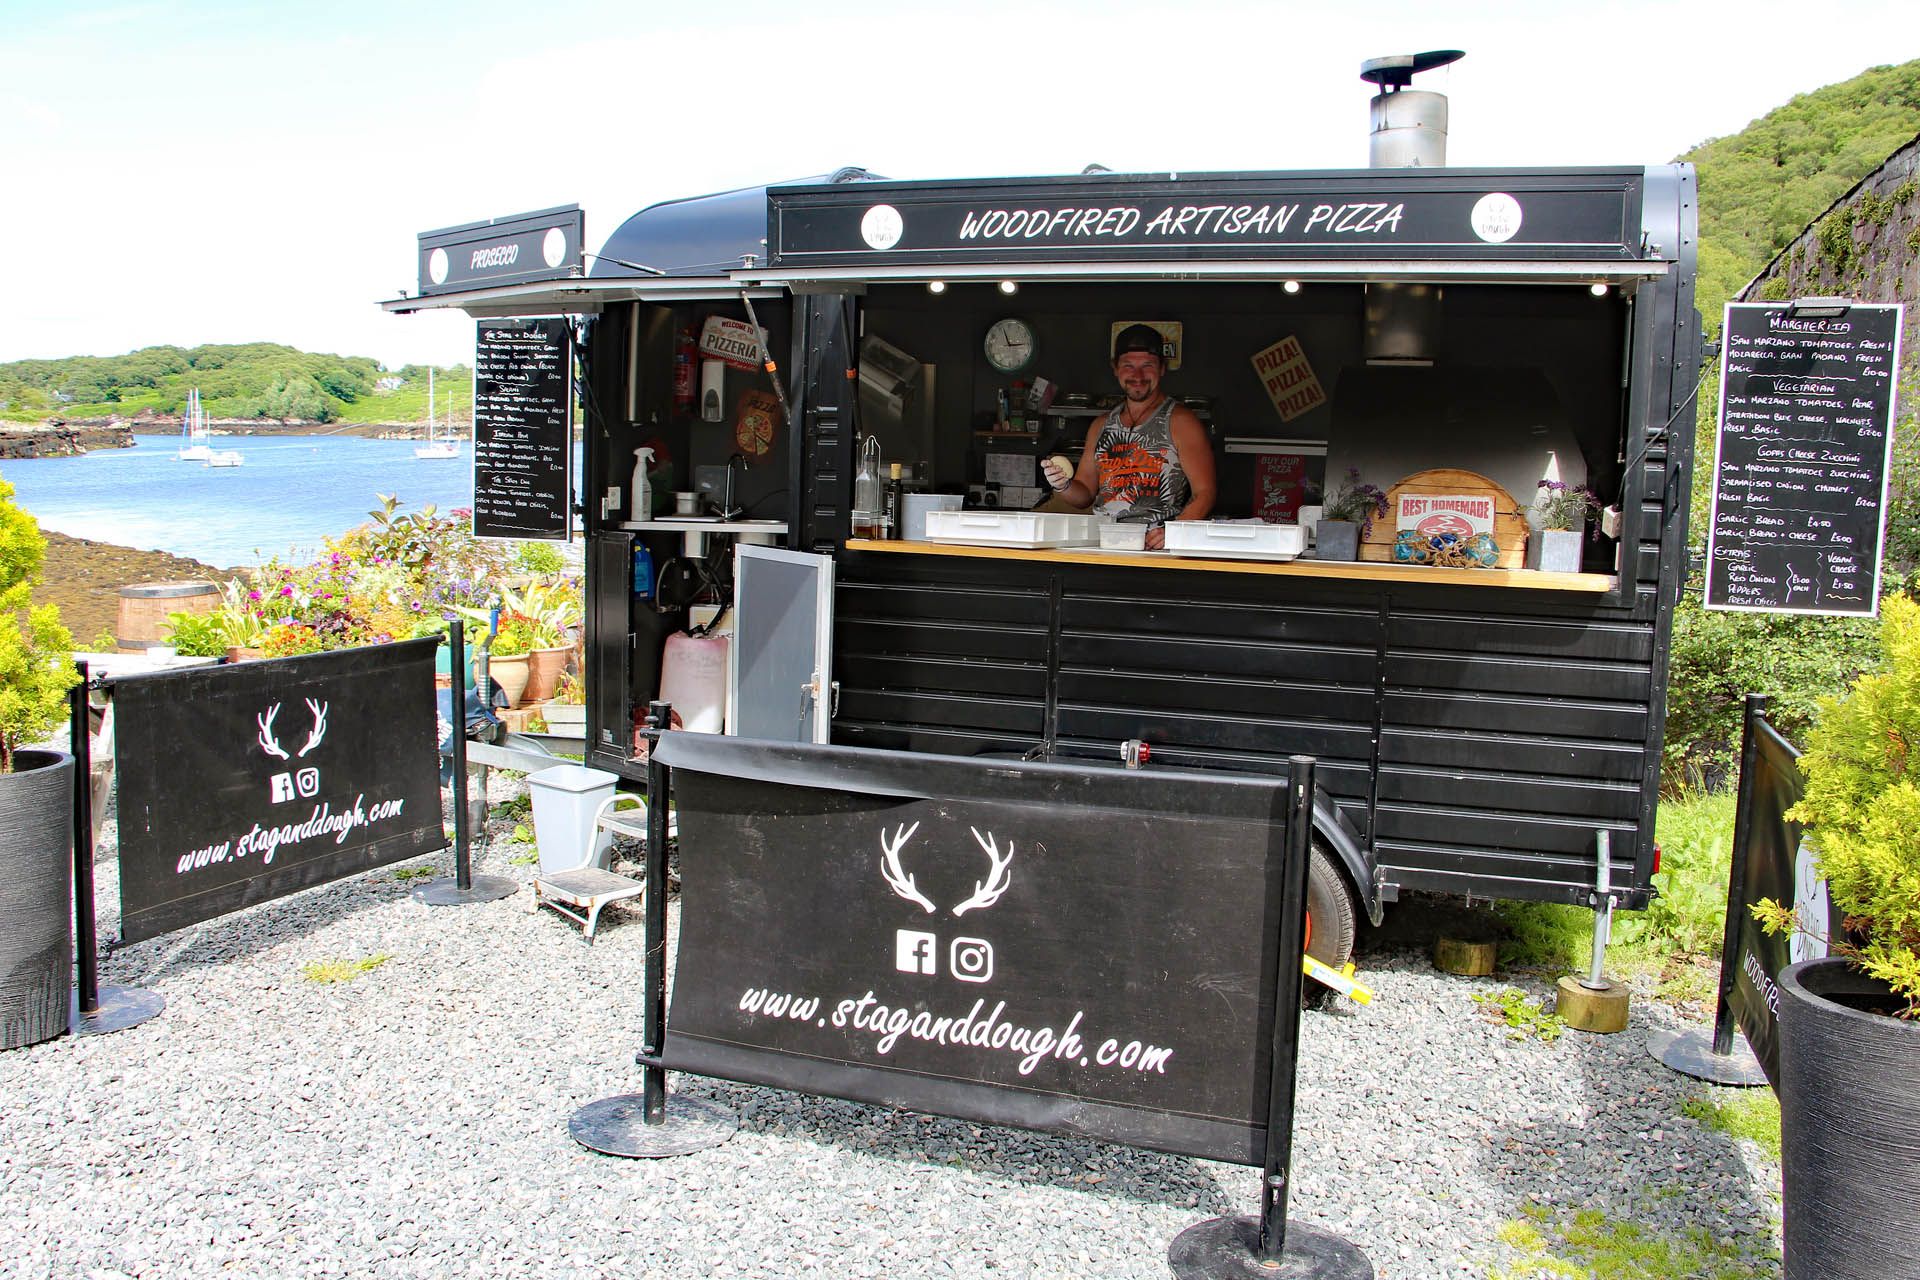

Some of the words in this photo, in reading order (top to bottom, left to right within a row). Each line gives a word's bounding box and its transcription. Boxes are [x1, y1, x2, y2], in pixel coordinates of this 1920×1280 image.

[959, 207, 1140, 240] WOODFIRED
[1145, 203, 1301, 236] ARTISAN
[1303, 202, 1404, 234] PIZZA
[470, 244, 519, 270] PROSECCO
[721, 321, 746, 332] WELCOME
[747, 326, 754, 335] TO
[1770, 317, 1850, 332] MARGHERITA
[706, 334, 757, 359] PIZZERIA
[1730, 335, 1750, 346] SAN
[1754, 336, 1795, 347] MARZANO
[1256, 340, 1300, 375] PIZZA!
[1781, 351, 1802, 360] GRAN
[1856, 353, 1882, 363] FRESH
[1267, 361, 1312, 396] PIZZA!
[1773, 379, 1835, 394] VEGETARIAN
[1278, 383, 1323, 418] PIZZA!
[1727, 394, 1746, 405] SAN
[1751, 396, 1789, 406] MARZANO
[1788, 445, 1816, 459] CHEESE
[1261, 456, 1279, 465] BUY
[1281, 457, 1300, 465] OUR
[1720, 461, 1739, 472] SAN
[1745, 463, 1780, 473] MARZANO
[1267, 465, 1292, 473] PIZZA
[1402, 499, 1428, 517] BEST
[1431, 500, 1489, 519] HOMEMADE
[1716, 513, 1749, 524] GARLIC
[1715, 527, 1745, 538] GARLIC
[1788, 531, 1818, 541] CHEESE
[1827, 552, 1852, 563] VEGAN
[1727, 563, 1758, 573] GARLIC
[1829, 565, 1858, 574] CHEESE
[1728, 572, 1746, 582] RED
[1749, 574, 1776, 584] ONIONS
[1728, 584, 1762, 596] PEPPERS
[176, 793, 404, 874] www.staganddough.com
[1743, 948, 1780, 1022] WOODFIRE
[738, 985, 1174, 1075] www.staganddough.com
